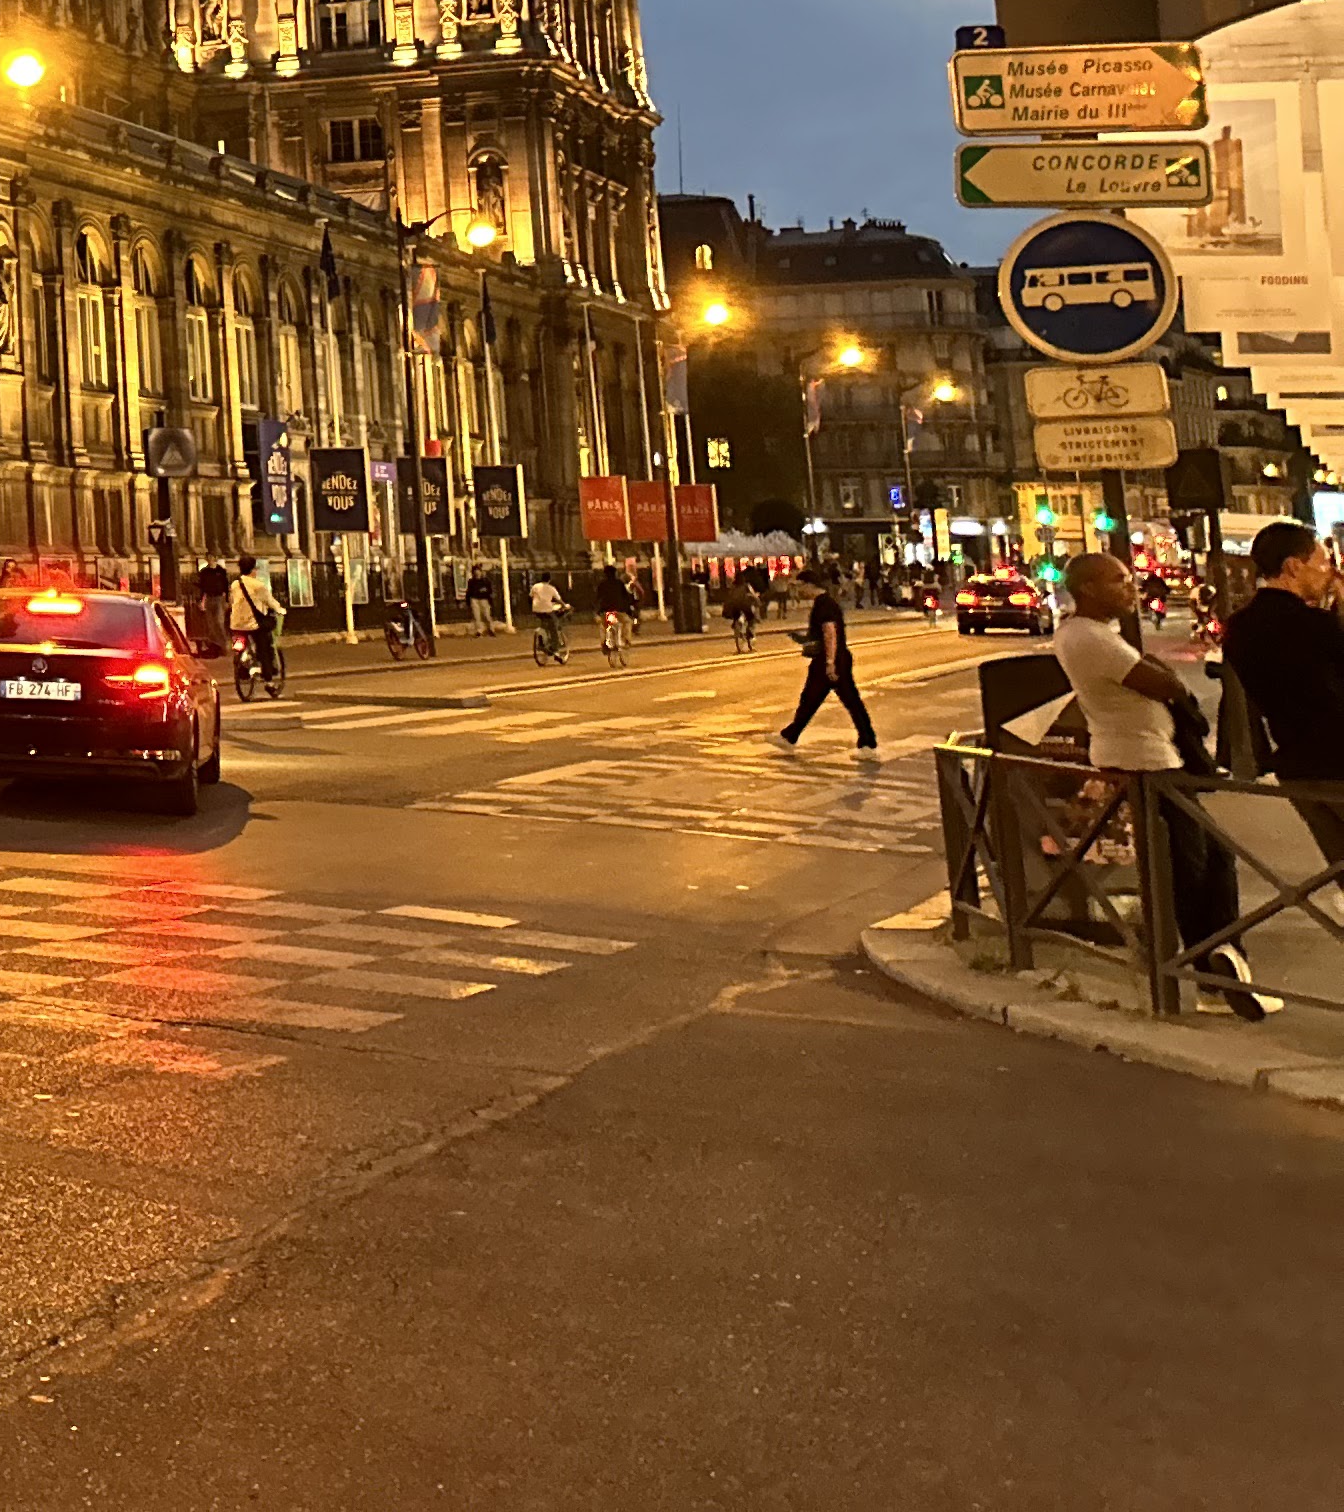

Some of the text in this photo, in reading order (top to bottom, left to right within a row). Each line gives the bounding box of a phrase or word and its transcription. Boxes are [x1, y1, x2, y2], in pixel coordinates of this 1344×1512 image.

[973, 27, 988, 46] 2
[1007, 58, 1153, 76] Musée Picasso
[1009, 82, 1063, 99] Musée
[1012, 105, 1069, 121] Mairie
[1077, 104, 1099, 119] du
[1032, 154, 1159, 172] CONCORDE
[1066, 177, 1161, 194] Le Louvre
[1261, 275, 1309, 285] FOODING
[1064, 425, 1137, 436] LIVRAISONS
[1061, 438, 1145, 450] STRICTEMENT
[321, 474, 358, 490] RENDEZ
[327, 495, 354, 511] VOUS
[587, 498, 621, 511] PARIS
[8, 682, 71, 697] FB 274 HF
